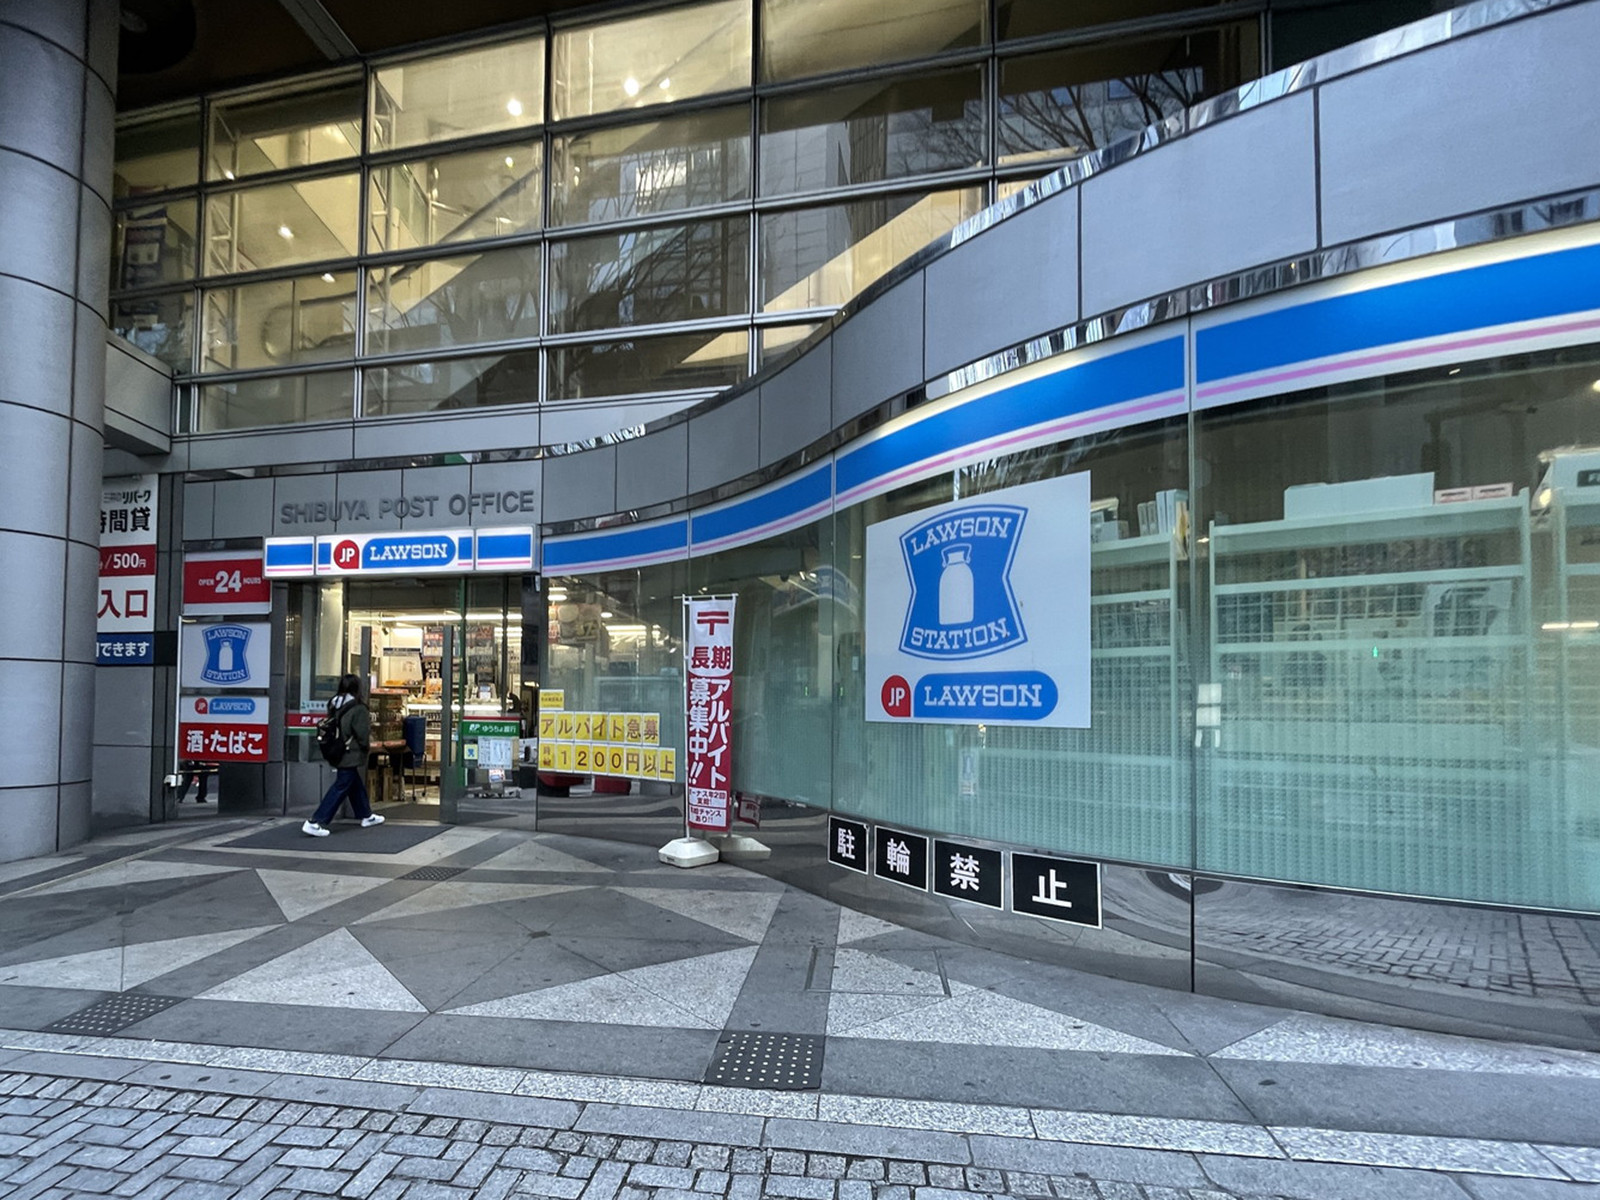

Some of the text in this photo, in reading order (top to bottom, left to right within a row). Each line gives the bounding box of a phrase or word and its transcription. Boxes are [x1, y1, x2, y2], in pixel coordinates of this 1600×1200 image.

[280, 490, 535, 525] SHIBUYA POST OFFICE
[911, 517, 1012, 556] LAWSON
[339, 543, 448, 562] JP LAWSON
[215, 570, 242, 593] 24
[97, 589, 149, 619] 入口
[207, 629, 247, 641] LAWSON
[911, 617, 1011, 650] STATION
[96, 642, 150, 658] できます
[691, 646, 731, 670] 長期
[206, 669, 247, 681] STATION
[212, 702, 253, 711] LAWSON
[888, 684, 1043, 707] JP LAWSON
[540, 717, 658, 740] アルバイト急募
[707, 678, 731, 789] アルバイト
[186, 730, 263, 755] 酒・たばこ
[837, 828, 1072, 908] 駐輪禁止
